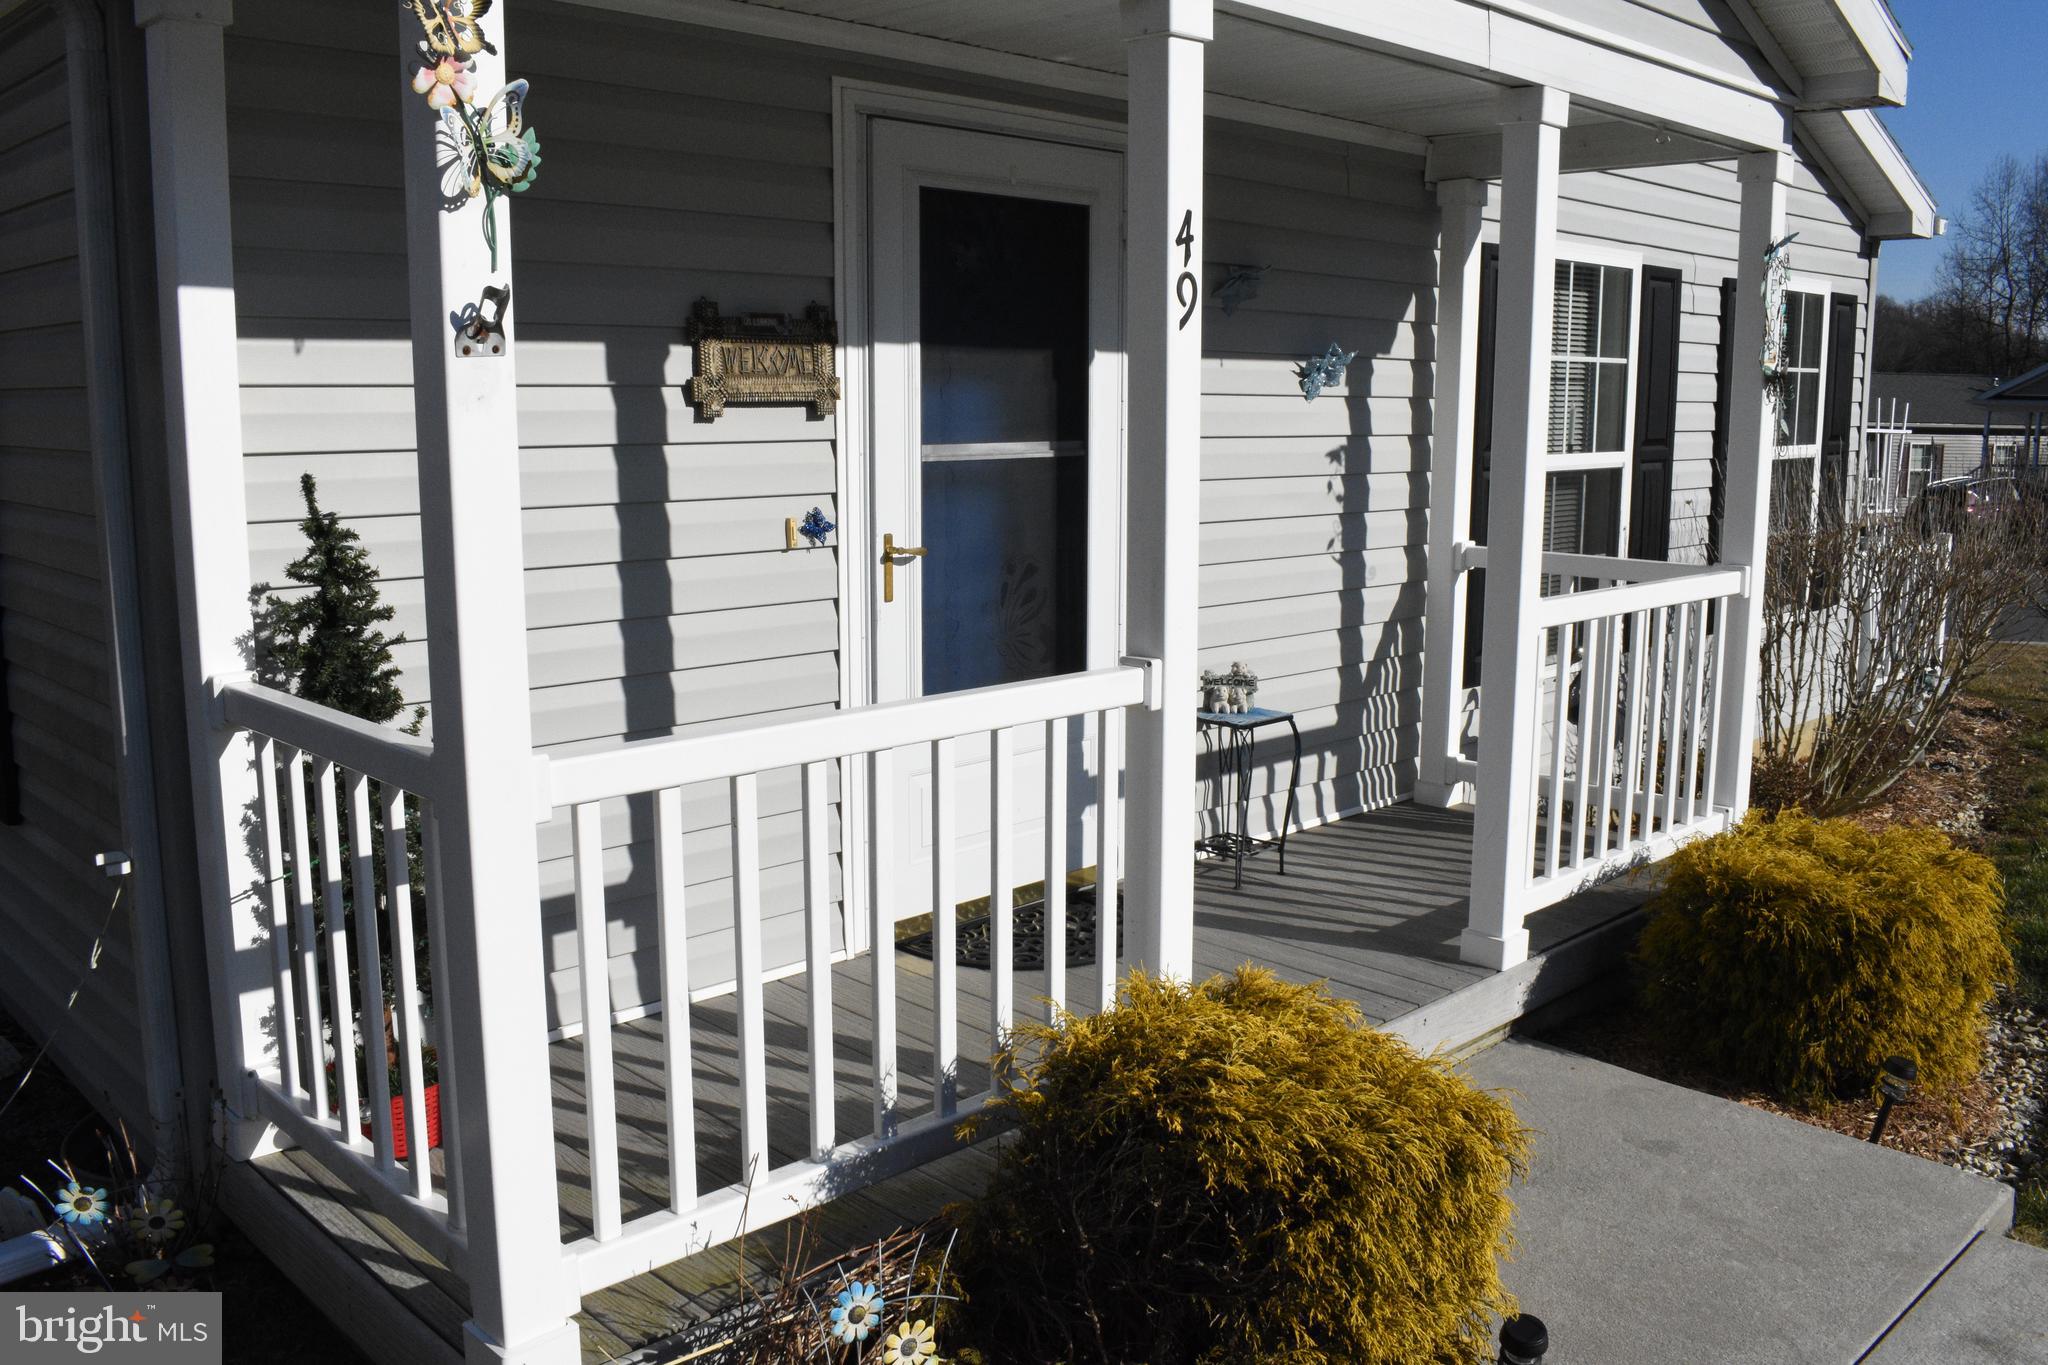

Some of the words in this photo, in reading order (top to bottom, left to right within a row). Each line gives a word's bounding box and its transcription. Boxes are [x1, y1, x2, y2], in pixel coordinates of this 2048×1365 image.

[1175, 209, 1198, 331] 49
[722, 345, 814, 375] WELCOME
[1207, 678, 1255, 687] WELCOME
